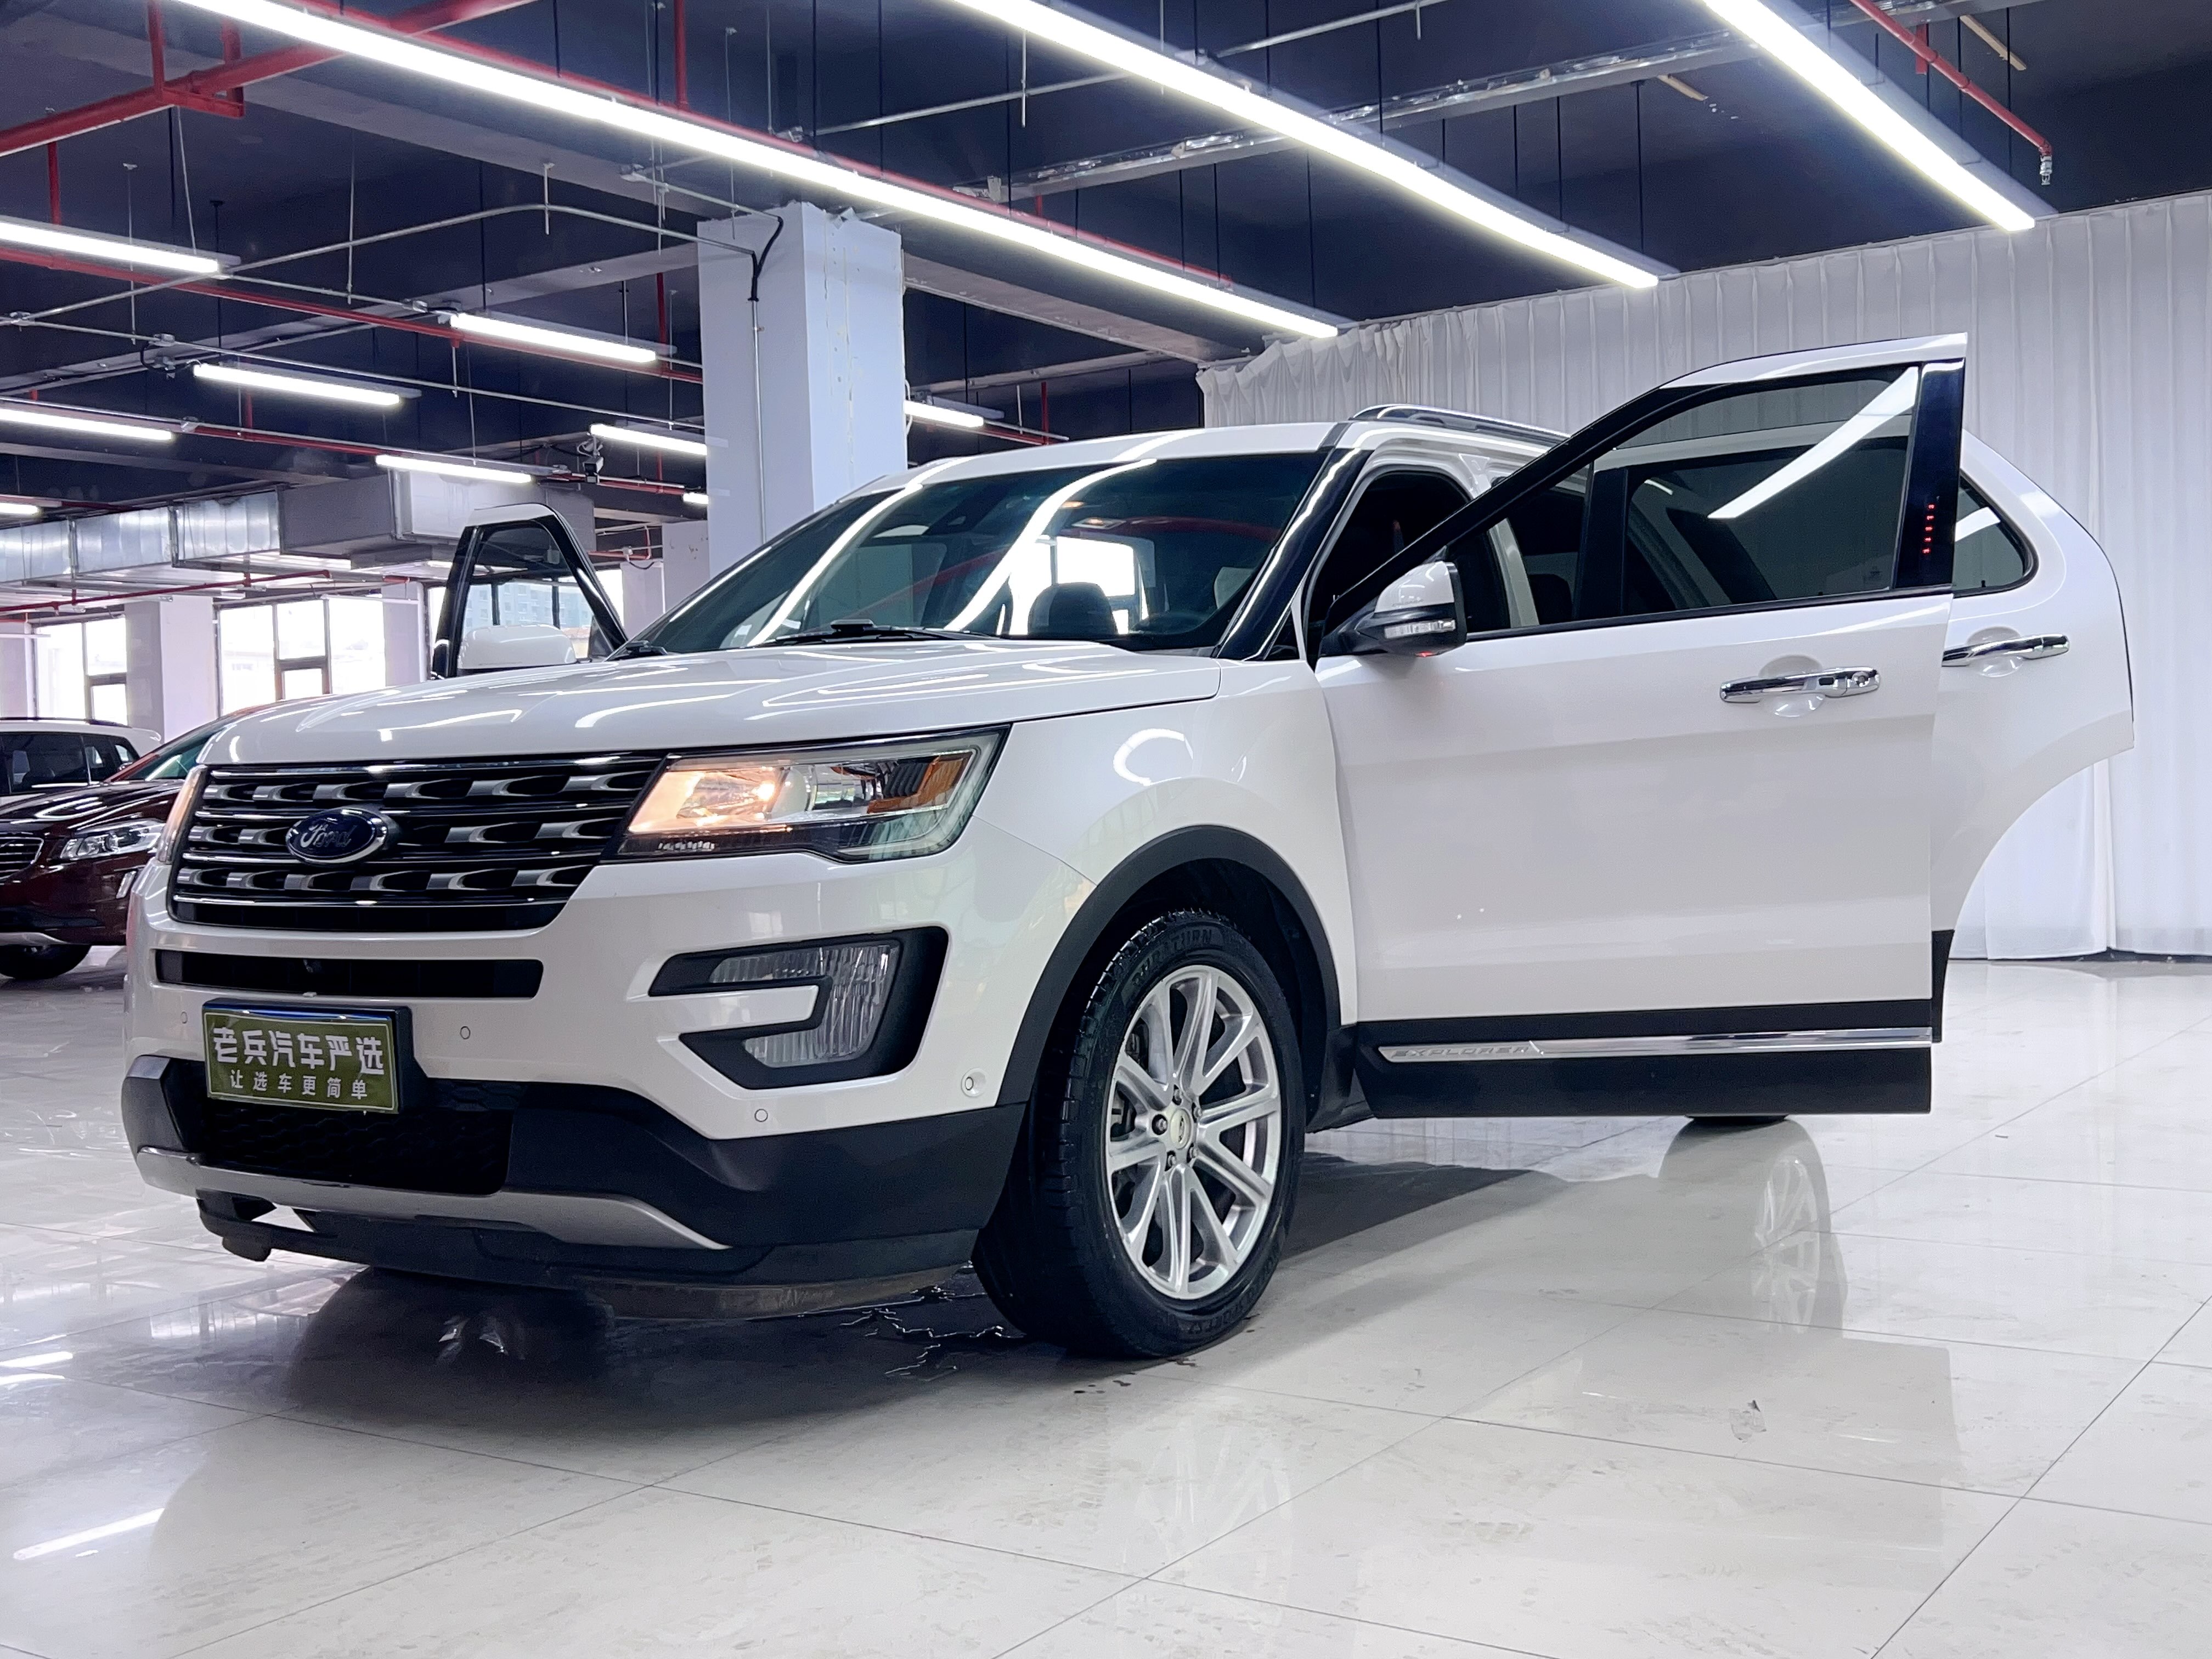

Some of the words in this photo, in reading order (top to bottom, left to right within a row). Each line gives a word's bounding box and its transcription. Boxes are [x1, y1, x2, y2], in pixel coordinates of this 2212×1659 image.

[300, 823, 357, 848] Ford
[213, 1026, 385, 1075] 老兵汽车严选
[230, 1069, 368, 1100] 让选车更简单
